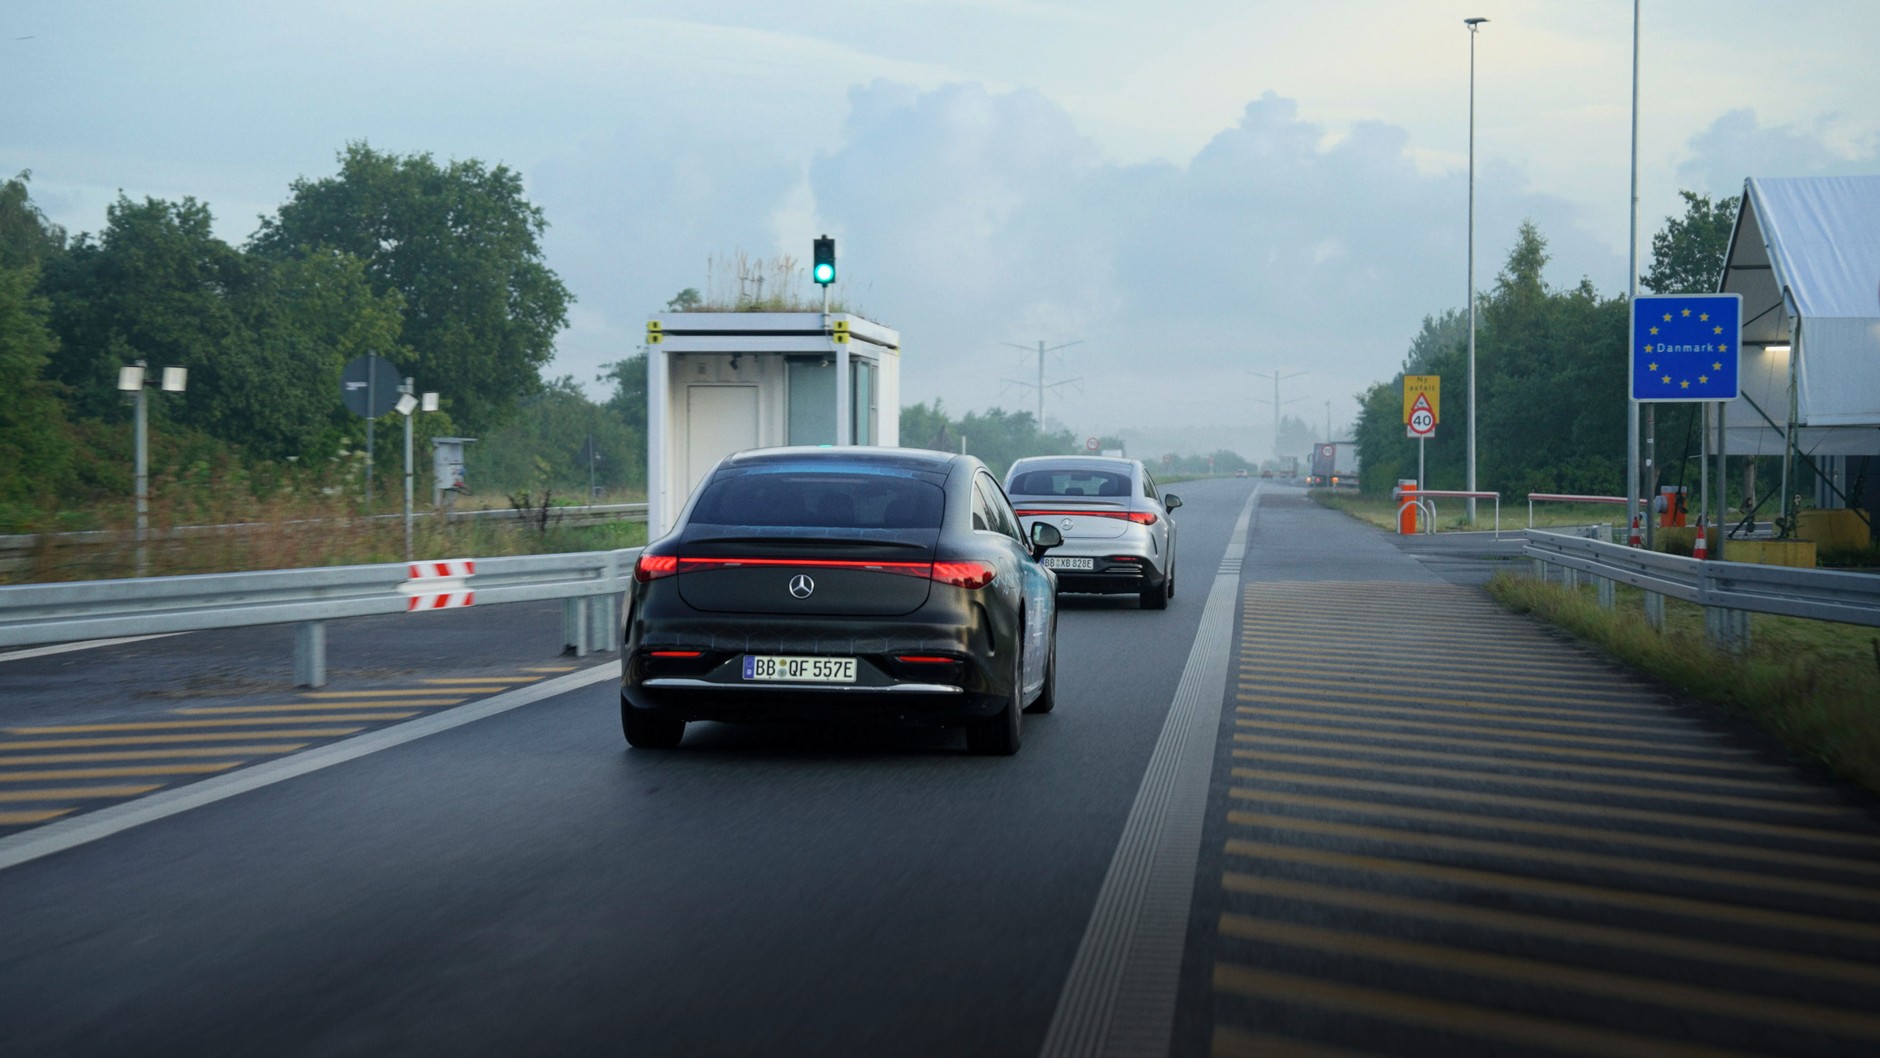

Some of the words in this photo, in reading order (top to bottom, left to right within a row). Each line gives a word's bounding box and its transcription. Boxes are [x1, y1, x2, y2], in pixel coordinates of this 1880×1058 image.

[1656, 343, 1714, 353] Danmark
[1413, 415, 1432, 426] 40
[1044, 558, 1055, 568] BB
[1060, 558, 1071, 568] XB
[1072, 559, 1092, 568] 828E
[755, 659, 776, 676] BB
[788, 660, 809, 677] QF
[813, 660, 853, 678] 557E
